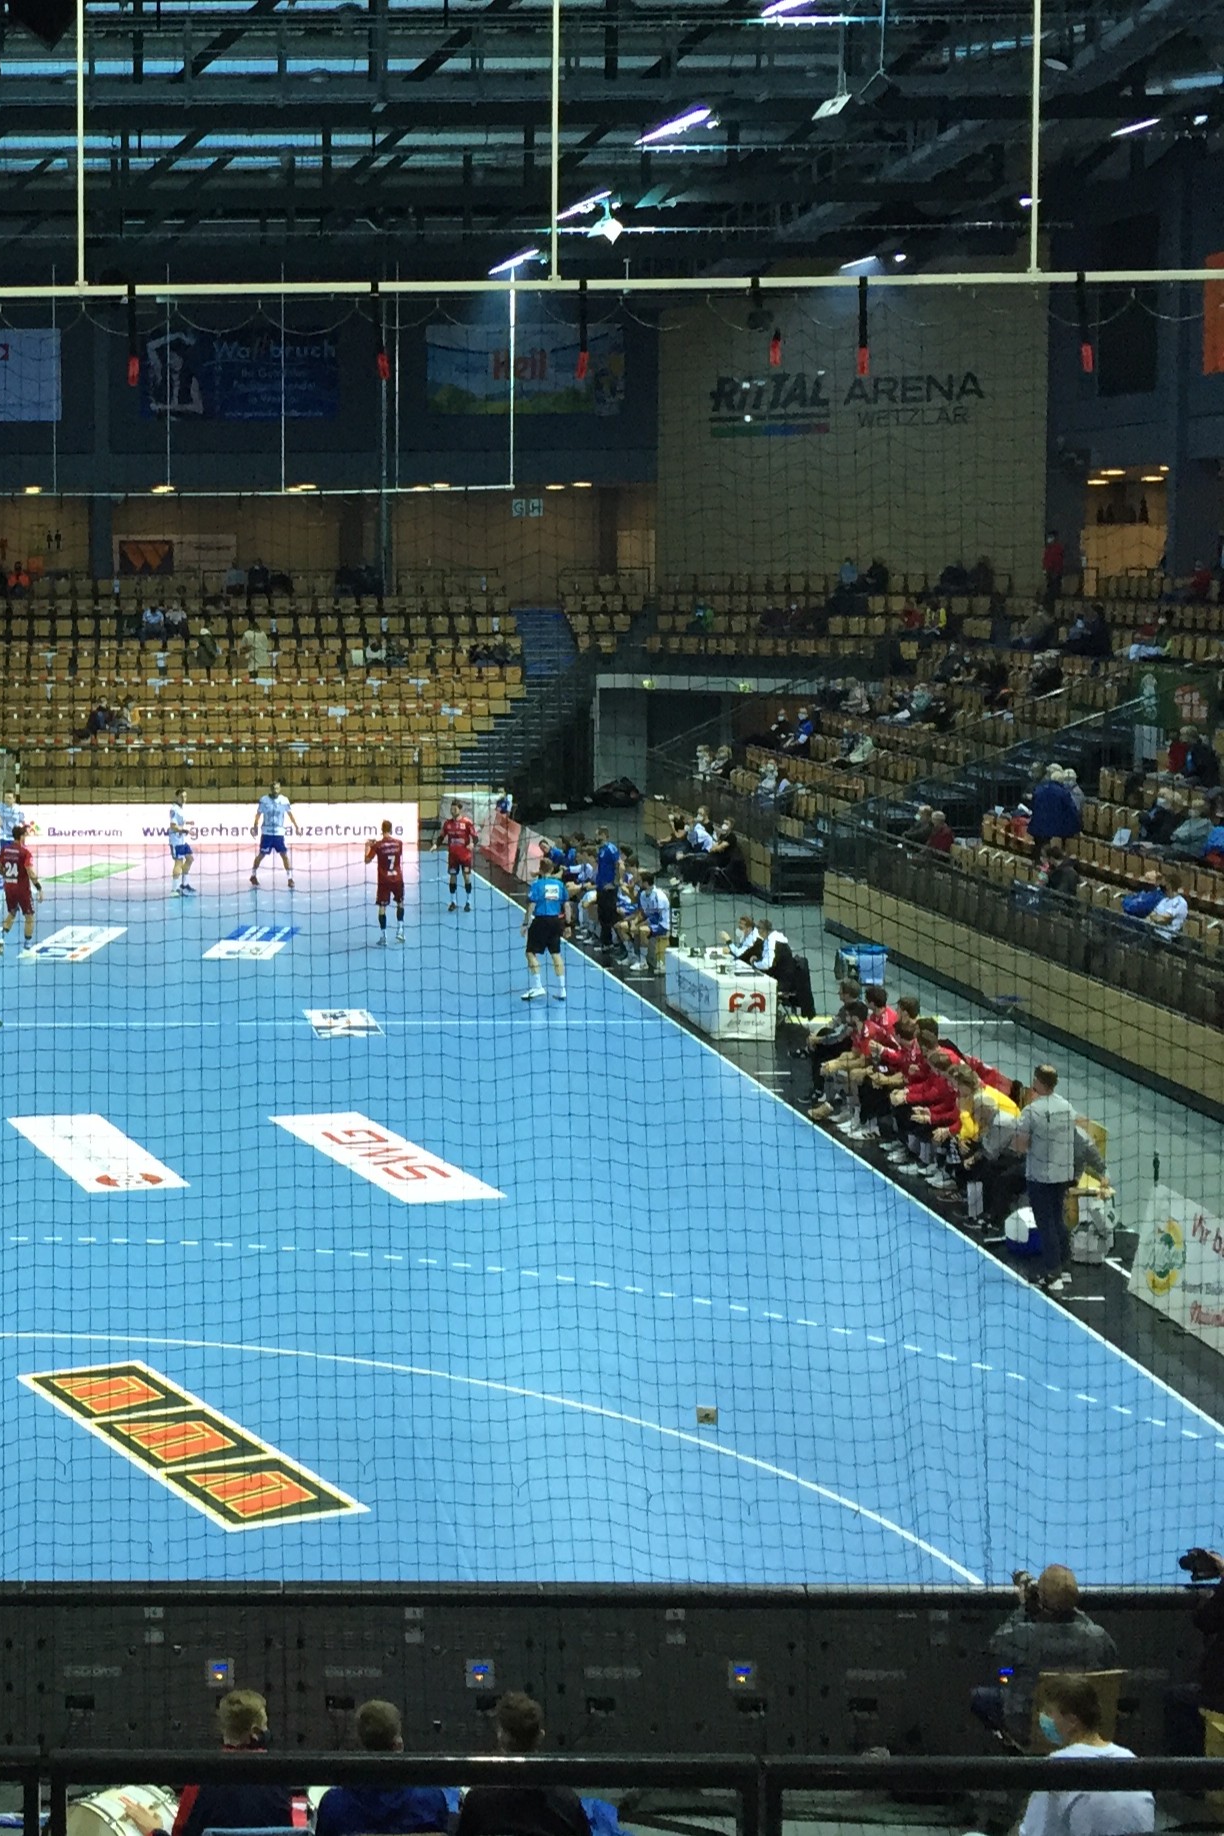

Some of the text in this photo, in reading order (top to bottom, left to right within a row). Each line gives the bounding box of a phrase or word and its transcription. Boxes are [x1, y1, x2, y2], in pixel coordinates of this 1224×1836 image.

[843, 371, 984, 405] ARENA
[857, 406, 969, 428] WETZLAR
[47, 827, 123, 838] Bauzentrum
[4, 861, 19, 877] 24
[388, 856, 396, 870] 7
[321, 1129, 452, 1180] SWG
